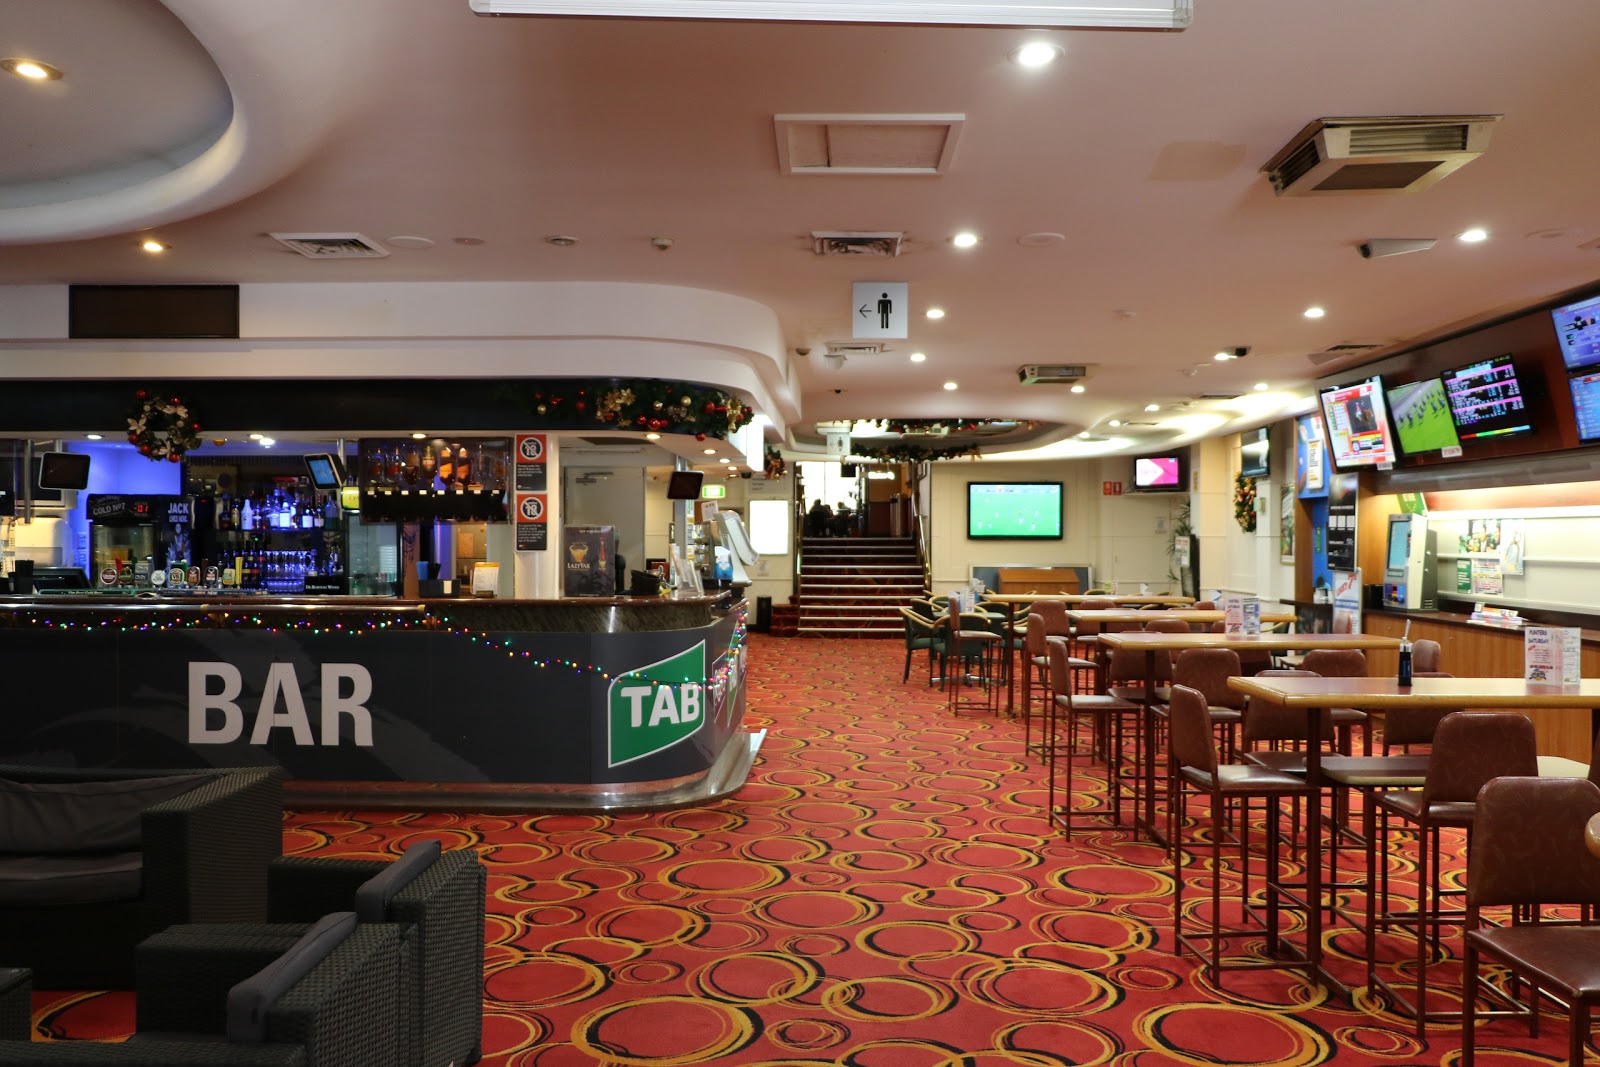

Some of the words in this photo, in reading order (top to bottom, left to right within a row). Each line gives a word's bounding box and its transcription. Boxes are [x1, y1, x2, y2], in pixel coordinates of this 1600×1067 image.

[93, 505, 111, 516] COLD
[168, 503, 189, 514] JACK
[188, 662, 373, 746] BAR
[620, 682, 700, 728] TAB
